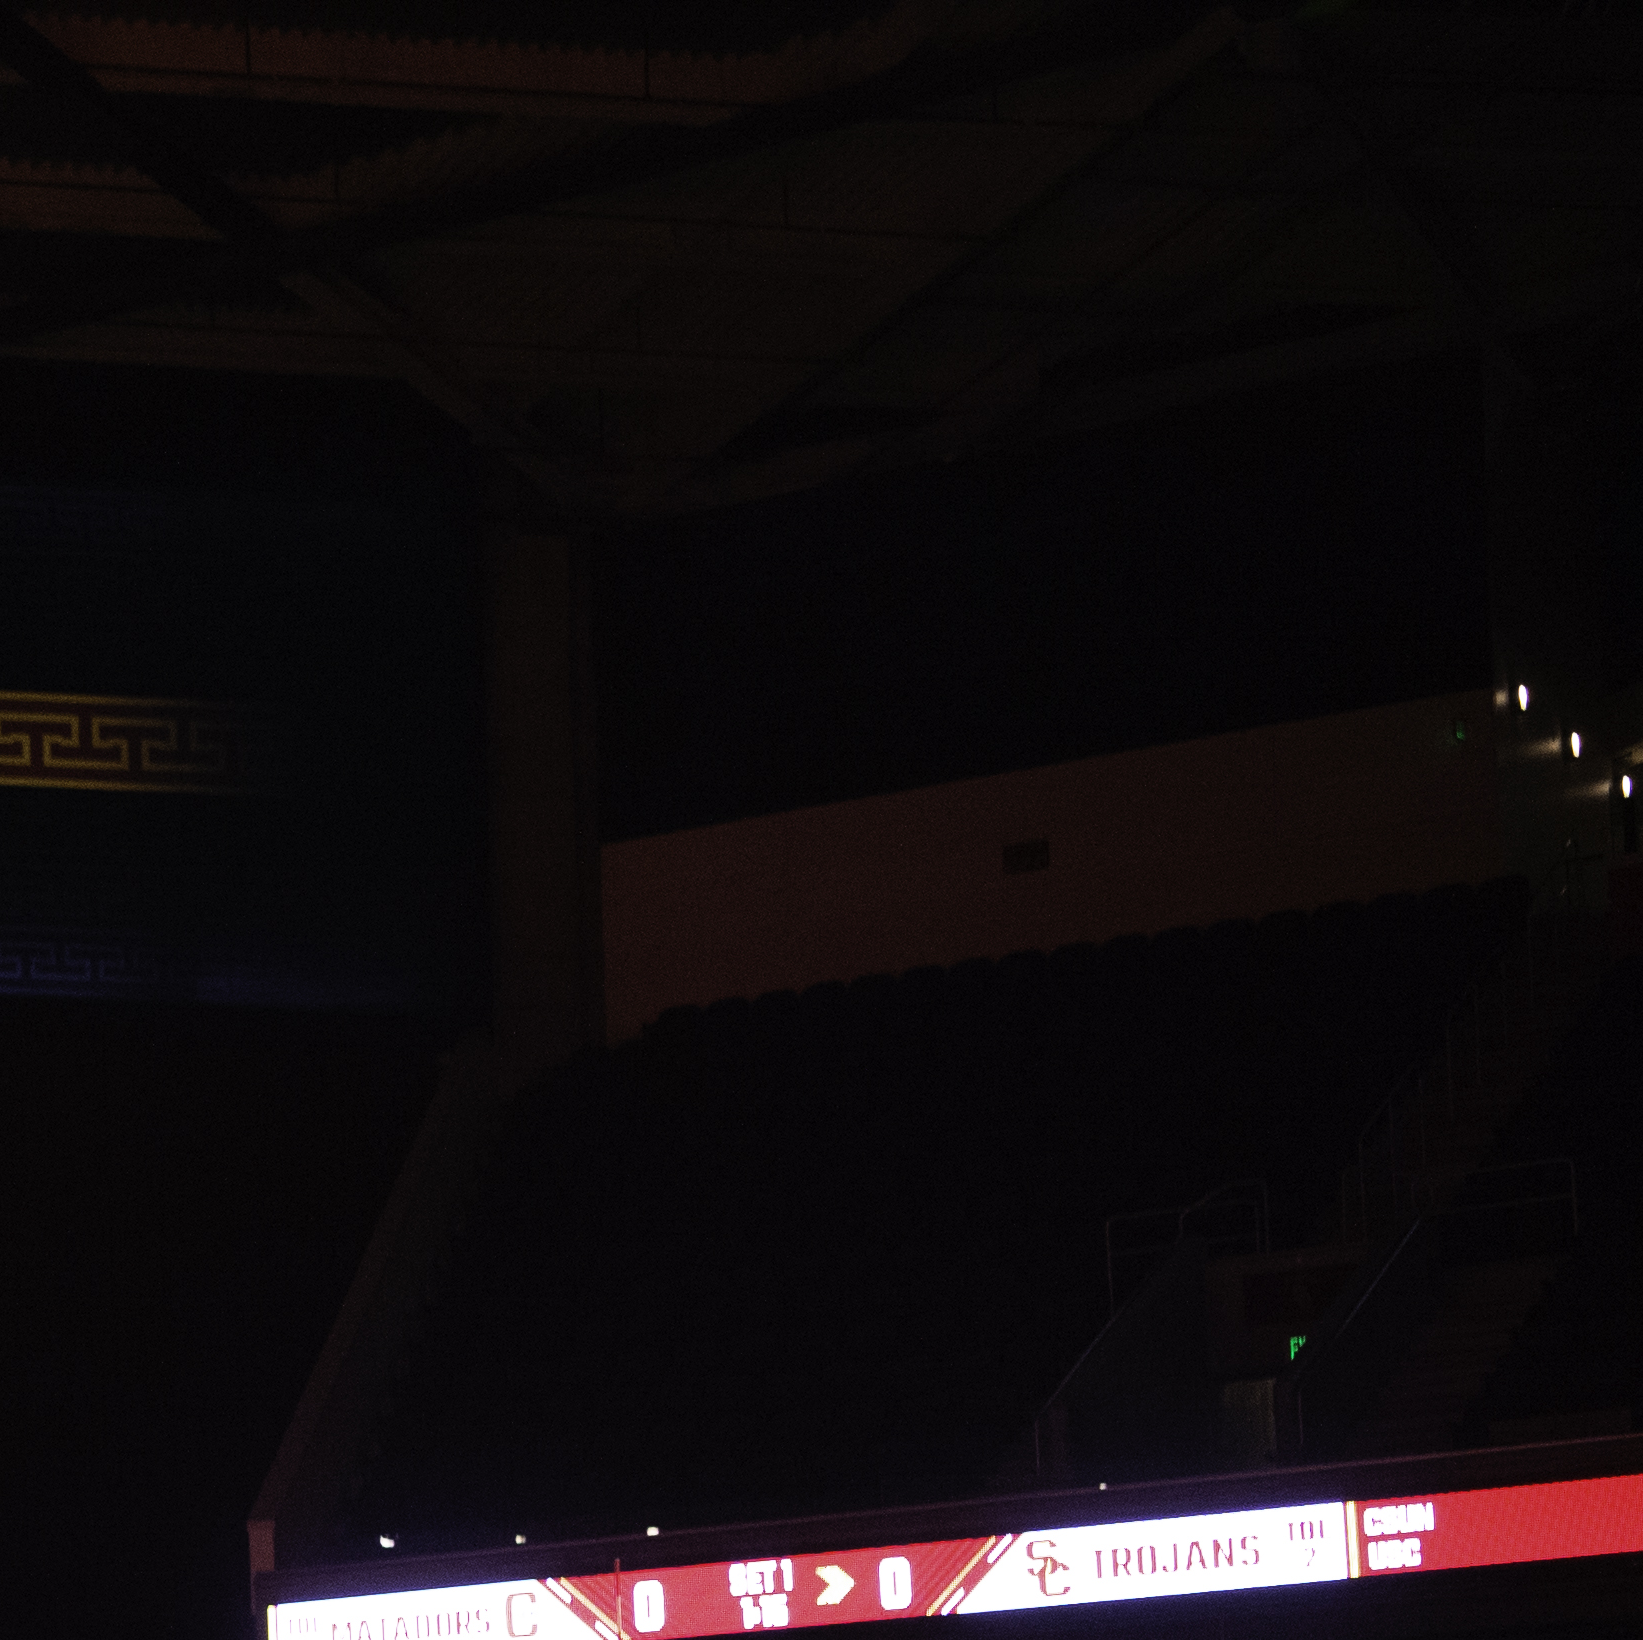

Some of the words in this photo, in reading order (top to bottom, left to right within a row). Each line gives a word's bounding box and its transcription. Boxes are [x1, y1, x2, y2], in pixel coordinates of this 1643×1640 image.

[727, 1560, 778, 1597] SET
[780, 1557, 794, 1592] 1
[1094, 1535, 1261, 1579] TROJANS
[633, 1579, 666, 1633] 0
[878, 1556, 913, 1611] 0
